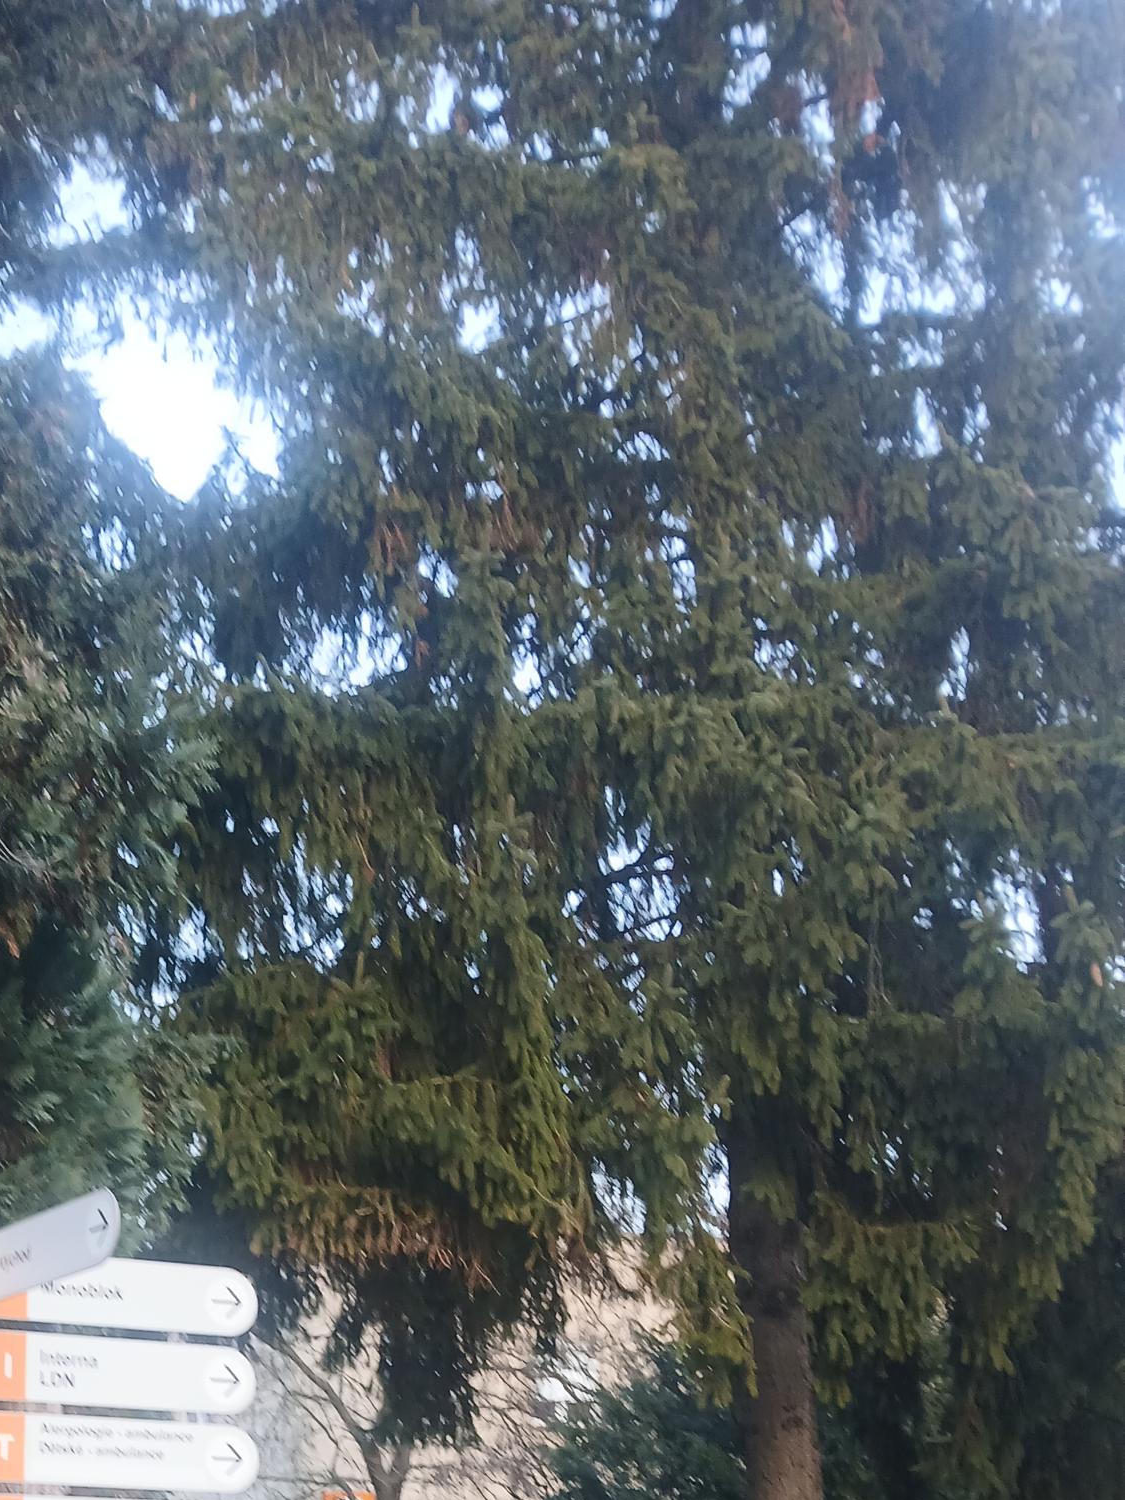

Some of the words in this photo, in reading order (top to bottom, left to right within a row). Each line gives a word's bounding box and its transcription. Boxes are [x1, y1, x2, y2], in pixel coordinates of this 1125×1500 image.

[3, 1351, 13, 1379] I
[39, 1348, 99, 1369] Interna
[39, 1370, 75, 1388] LDN
